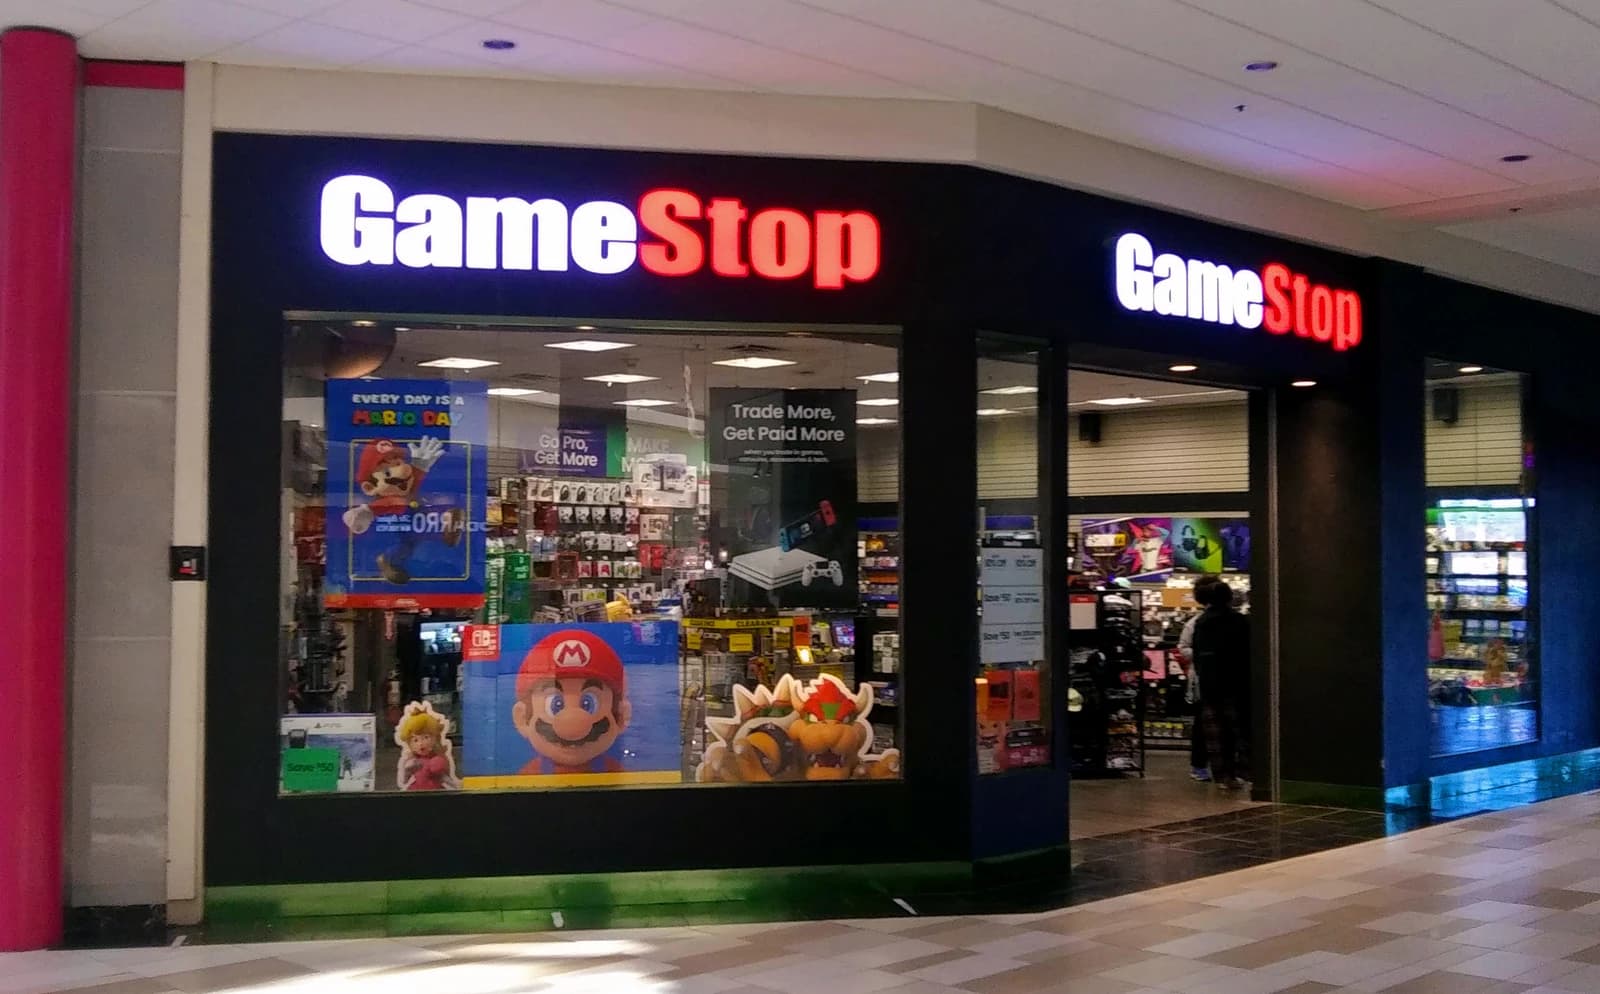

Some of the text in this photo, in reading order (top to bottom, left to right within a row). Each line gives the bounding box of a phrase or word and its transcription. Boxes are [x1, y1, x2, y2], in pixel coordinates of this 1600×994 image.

[320, 174, 881, 289] GameStop
[1116, 233, 1362, 351] GameStop
[352, 394, 464, 405] EVERY DAY IS A
[352, 410, 464, 426] MARIO DAY
[731, 404, 836, 421] Trade More,
[723, 425, 845, 441] Get Paid More
[539, 434, 589, 451] Go Pro,
[628, 439, 670, 453] MAKE
[534, 451, 598, 467] Get More
